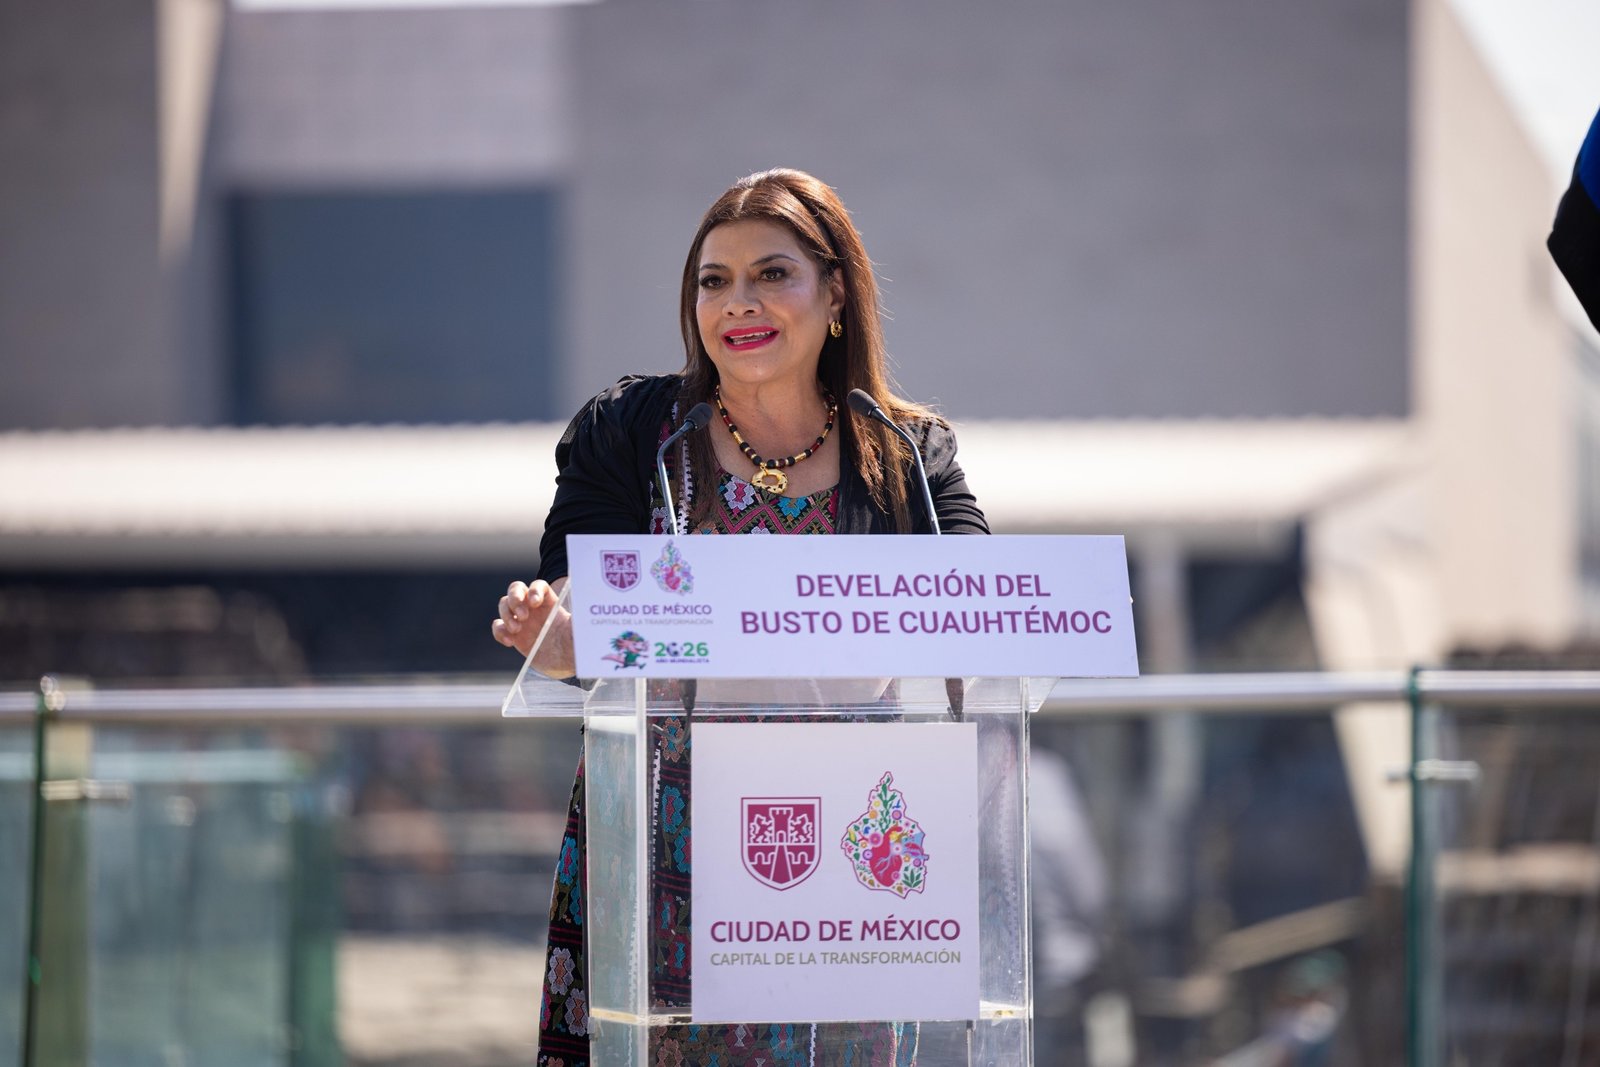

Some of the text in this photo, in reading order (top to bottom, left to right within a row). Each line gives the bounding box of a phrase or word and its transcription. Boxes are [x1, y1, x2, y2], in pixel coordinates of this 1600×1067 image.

[796, 568, 1052, 598] DEVELACIÓN DEL
[589, 602, 713, 615] CIUDAD DE MÉXICO
[740, 605, 1112, 635] BUSTO DE CUAUHTÉMOC
[645, 617, 714, 625] TRANSFORMACIÓN
[710, 914, 961, 943] CIUDAD DE MÉXICO
[710, 948, 961, 966] CAPITAL DE LA TRANSFORMACIÓN
